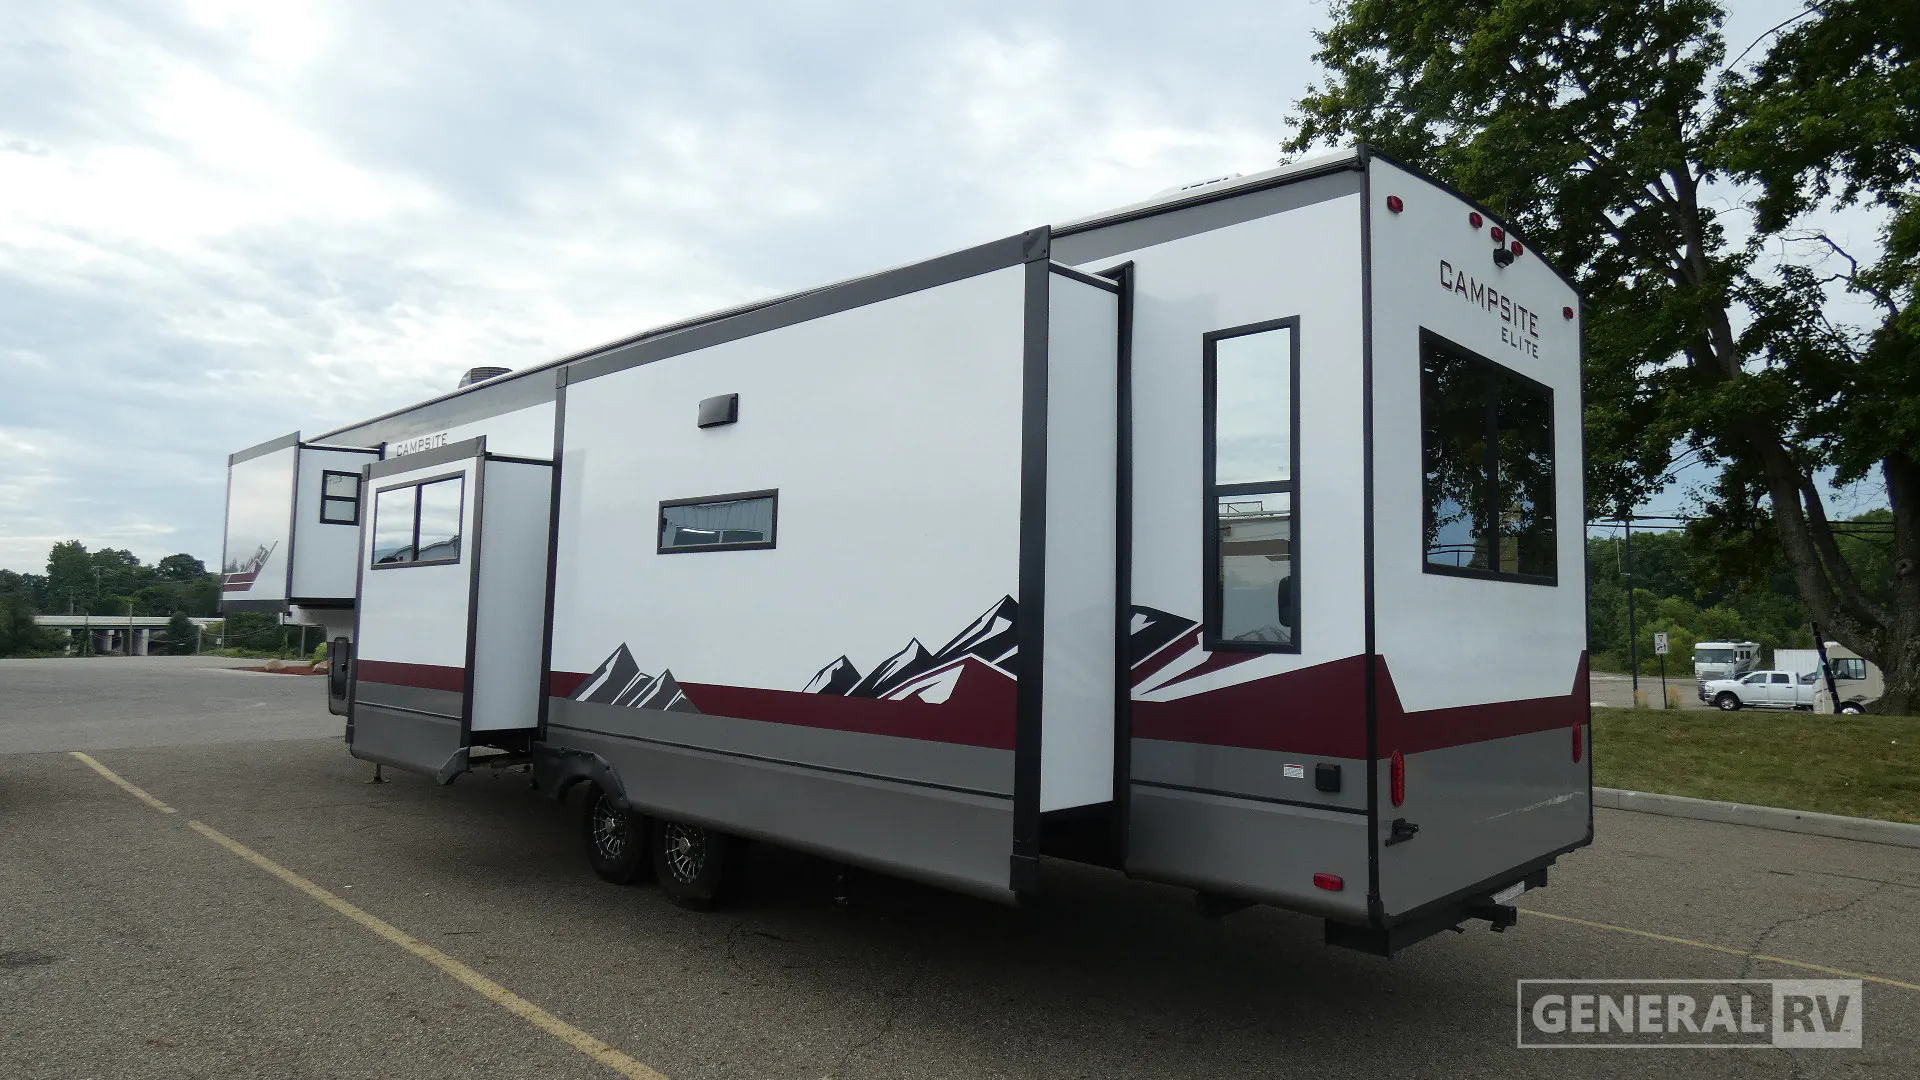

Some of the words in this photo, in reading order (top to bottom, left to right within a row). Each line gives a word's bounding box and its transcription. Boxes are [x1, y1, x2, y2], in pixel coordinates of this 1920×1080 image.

[1440, 259, 1539, 339] CAMPSITE
[1501, 326, 1539, 360] ELITE
[396, 433, 448, 457] CAMPSITE
